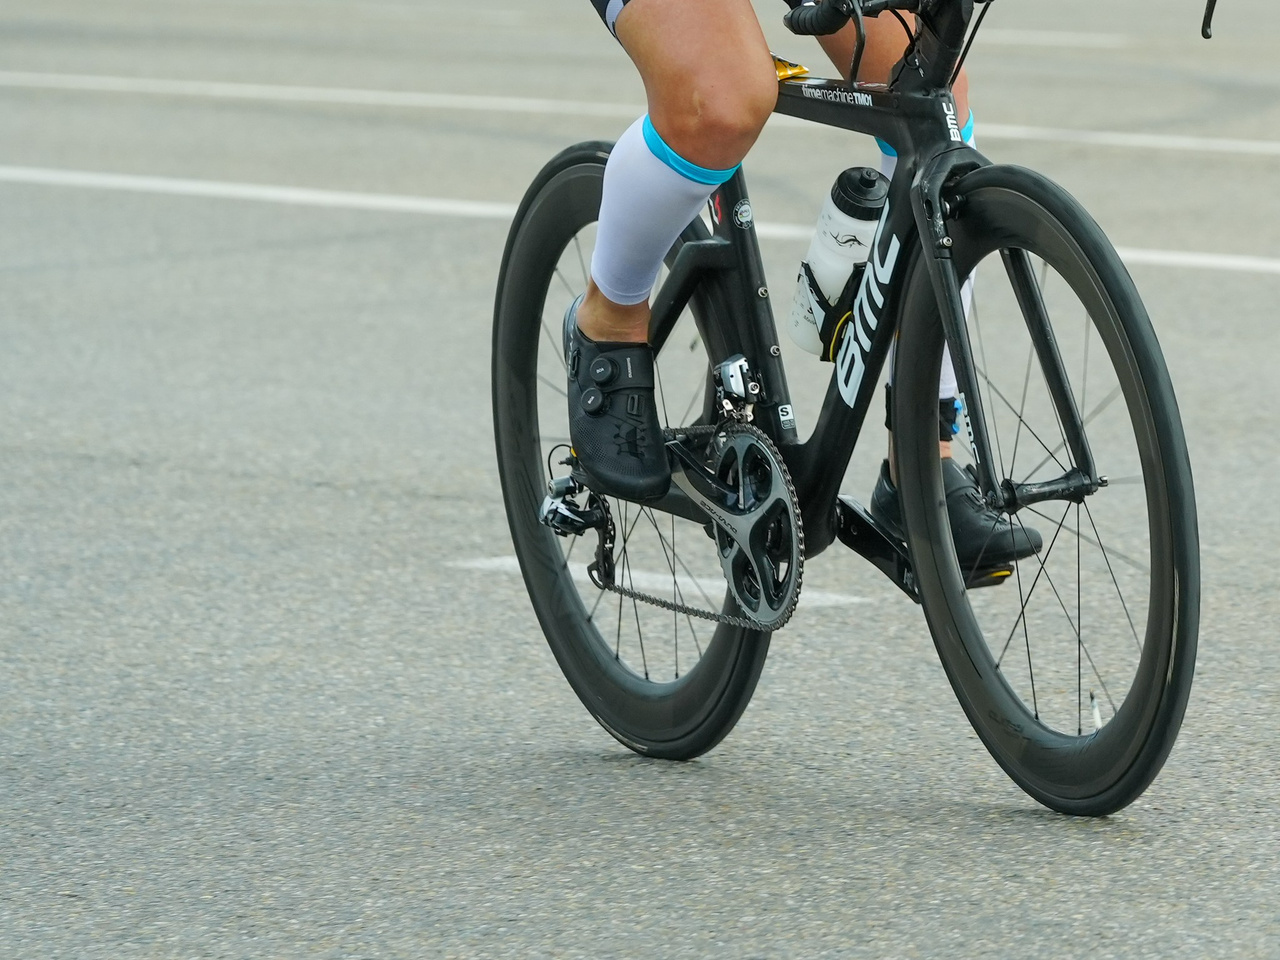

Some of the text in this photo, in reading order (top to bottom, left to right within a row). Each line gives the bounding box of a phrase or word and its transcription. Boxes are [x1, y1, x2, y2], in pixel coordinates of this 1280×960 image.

[942, 102, 962, 142] BMC
[836, 197, 900, 409] BMC
[780, 406, 789, 417] S
